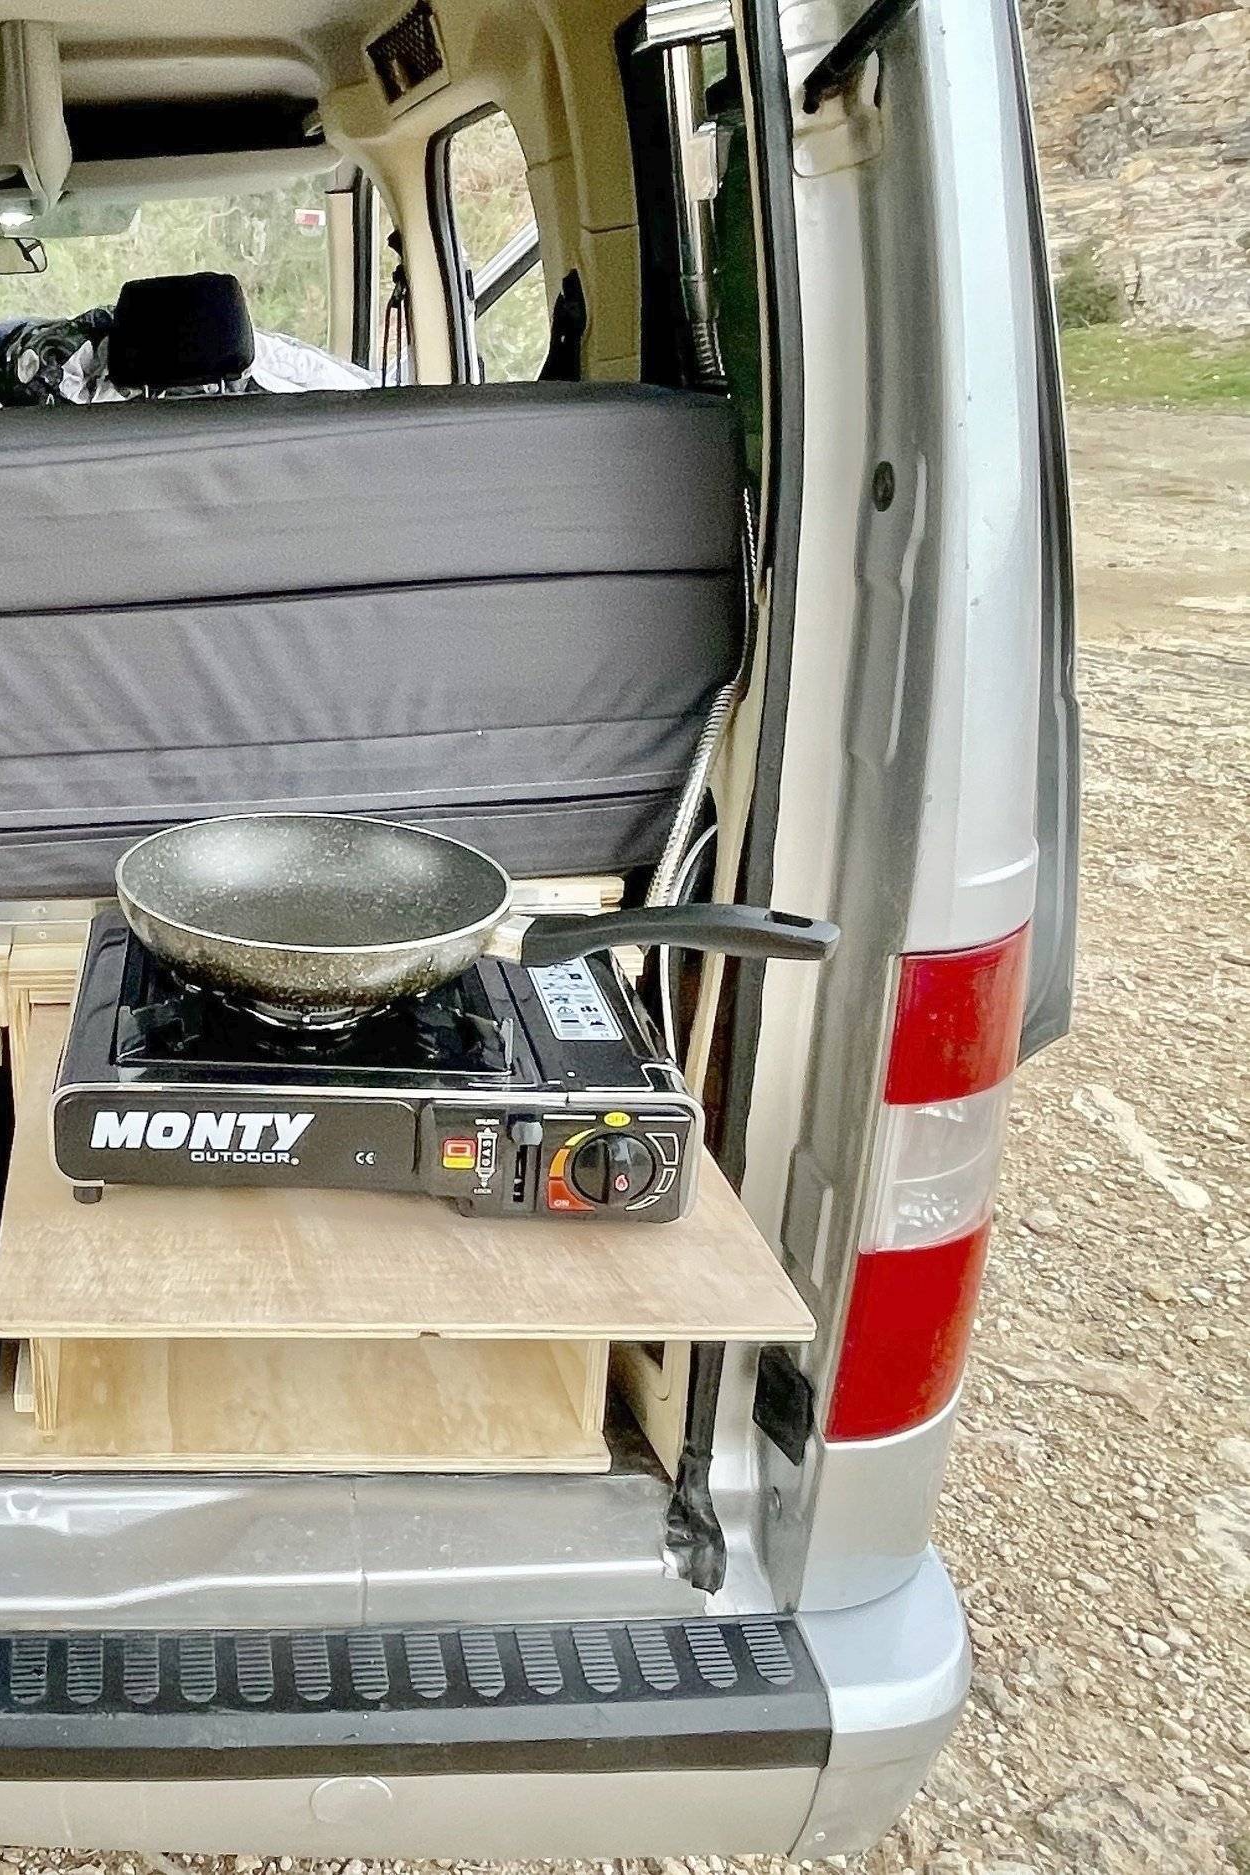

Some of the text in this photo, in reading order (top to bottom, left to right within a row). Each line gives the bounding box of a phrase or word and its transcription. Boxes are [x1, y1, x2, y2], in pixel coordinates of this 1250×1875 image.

[607, 1115, 626, 1124] OFF
[90, 1111, 315, 1151] MONTY
[355, 1152, 375, 1165] CE
[481, 1140, 493, 1167] GAS
[553, 1199, 570, 1208] ON
